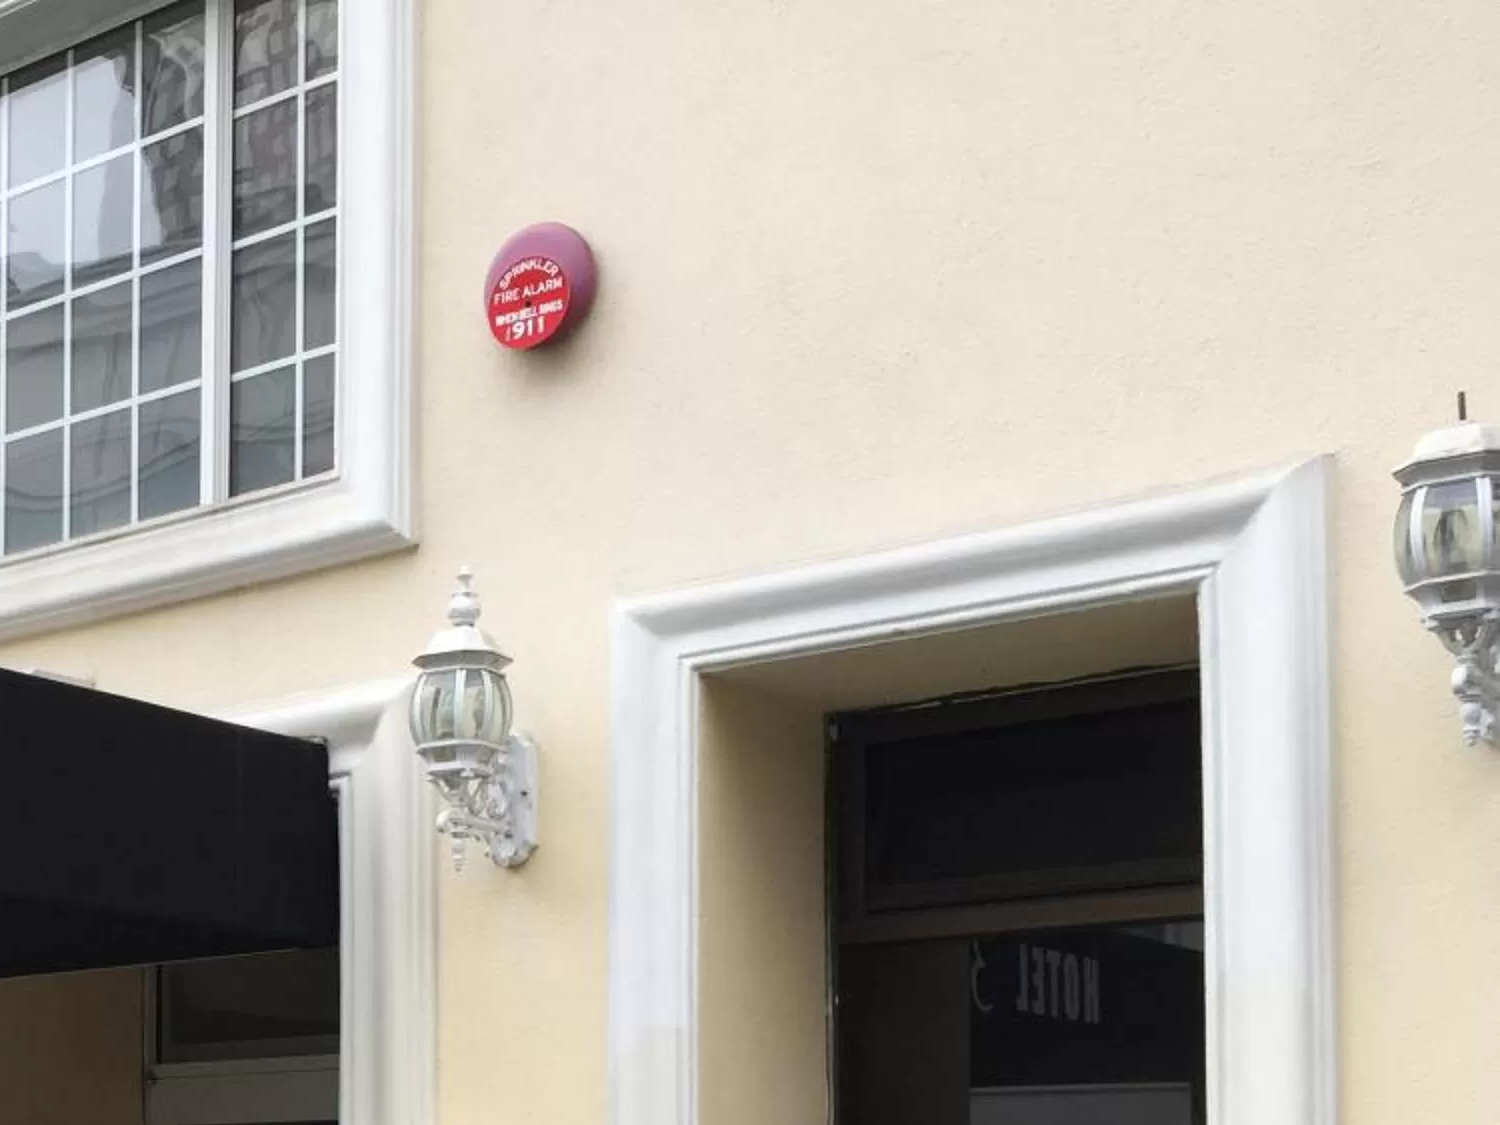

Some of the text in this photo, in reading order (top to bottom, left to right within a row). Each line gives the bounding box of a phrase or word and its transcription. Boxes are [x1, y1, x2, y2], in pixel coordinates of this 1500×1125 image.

[500, 259, 559, 289] SPRINKLER
[493, 276, 563, 304] FIRE ALARM
